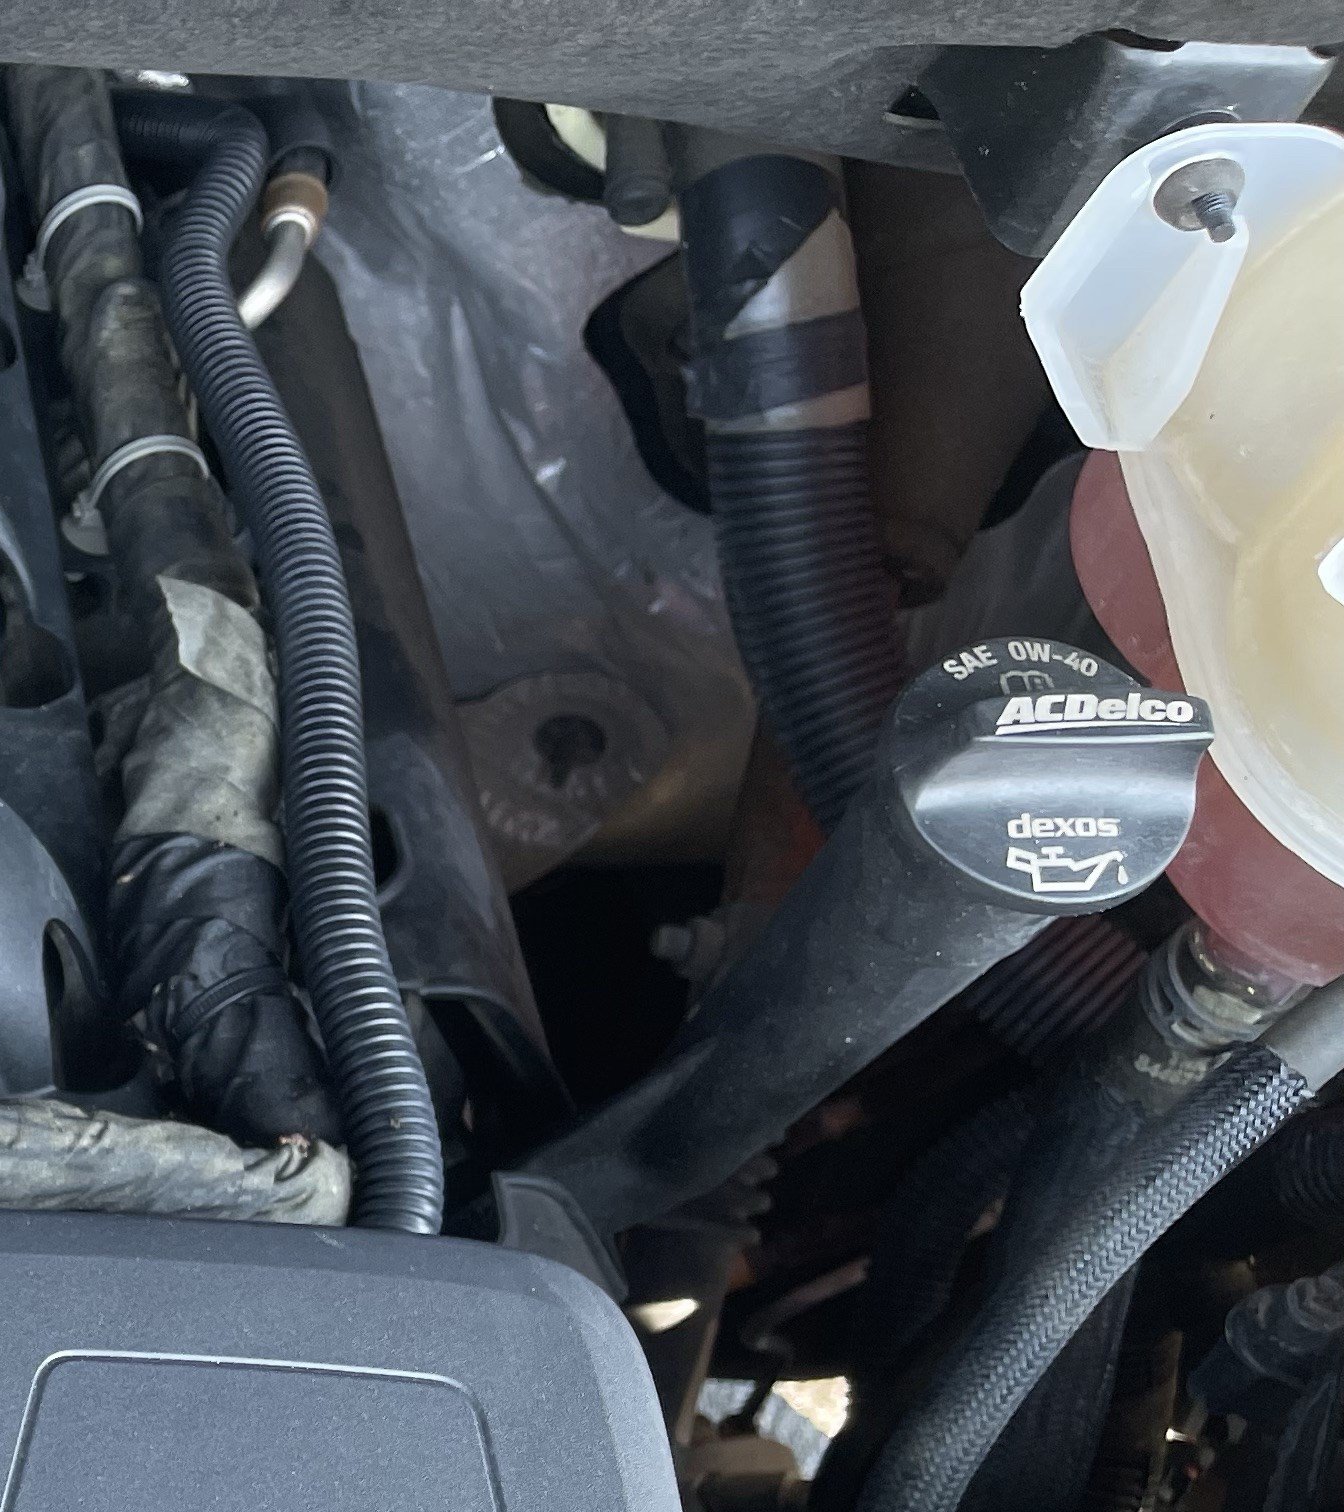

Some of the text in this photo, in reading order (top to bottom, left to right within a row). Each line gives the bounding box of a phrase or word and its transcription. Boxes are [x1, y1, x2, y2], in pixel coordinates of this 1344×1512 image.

[942, 641, 1100, 681] SAE 0W-40
[995, 693, 1194, 726] ACDelco
[1007, 812, 1121, 839] dexos
